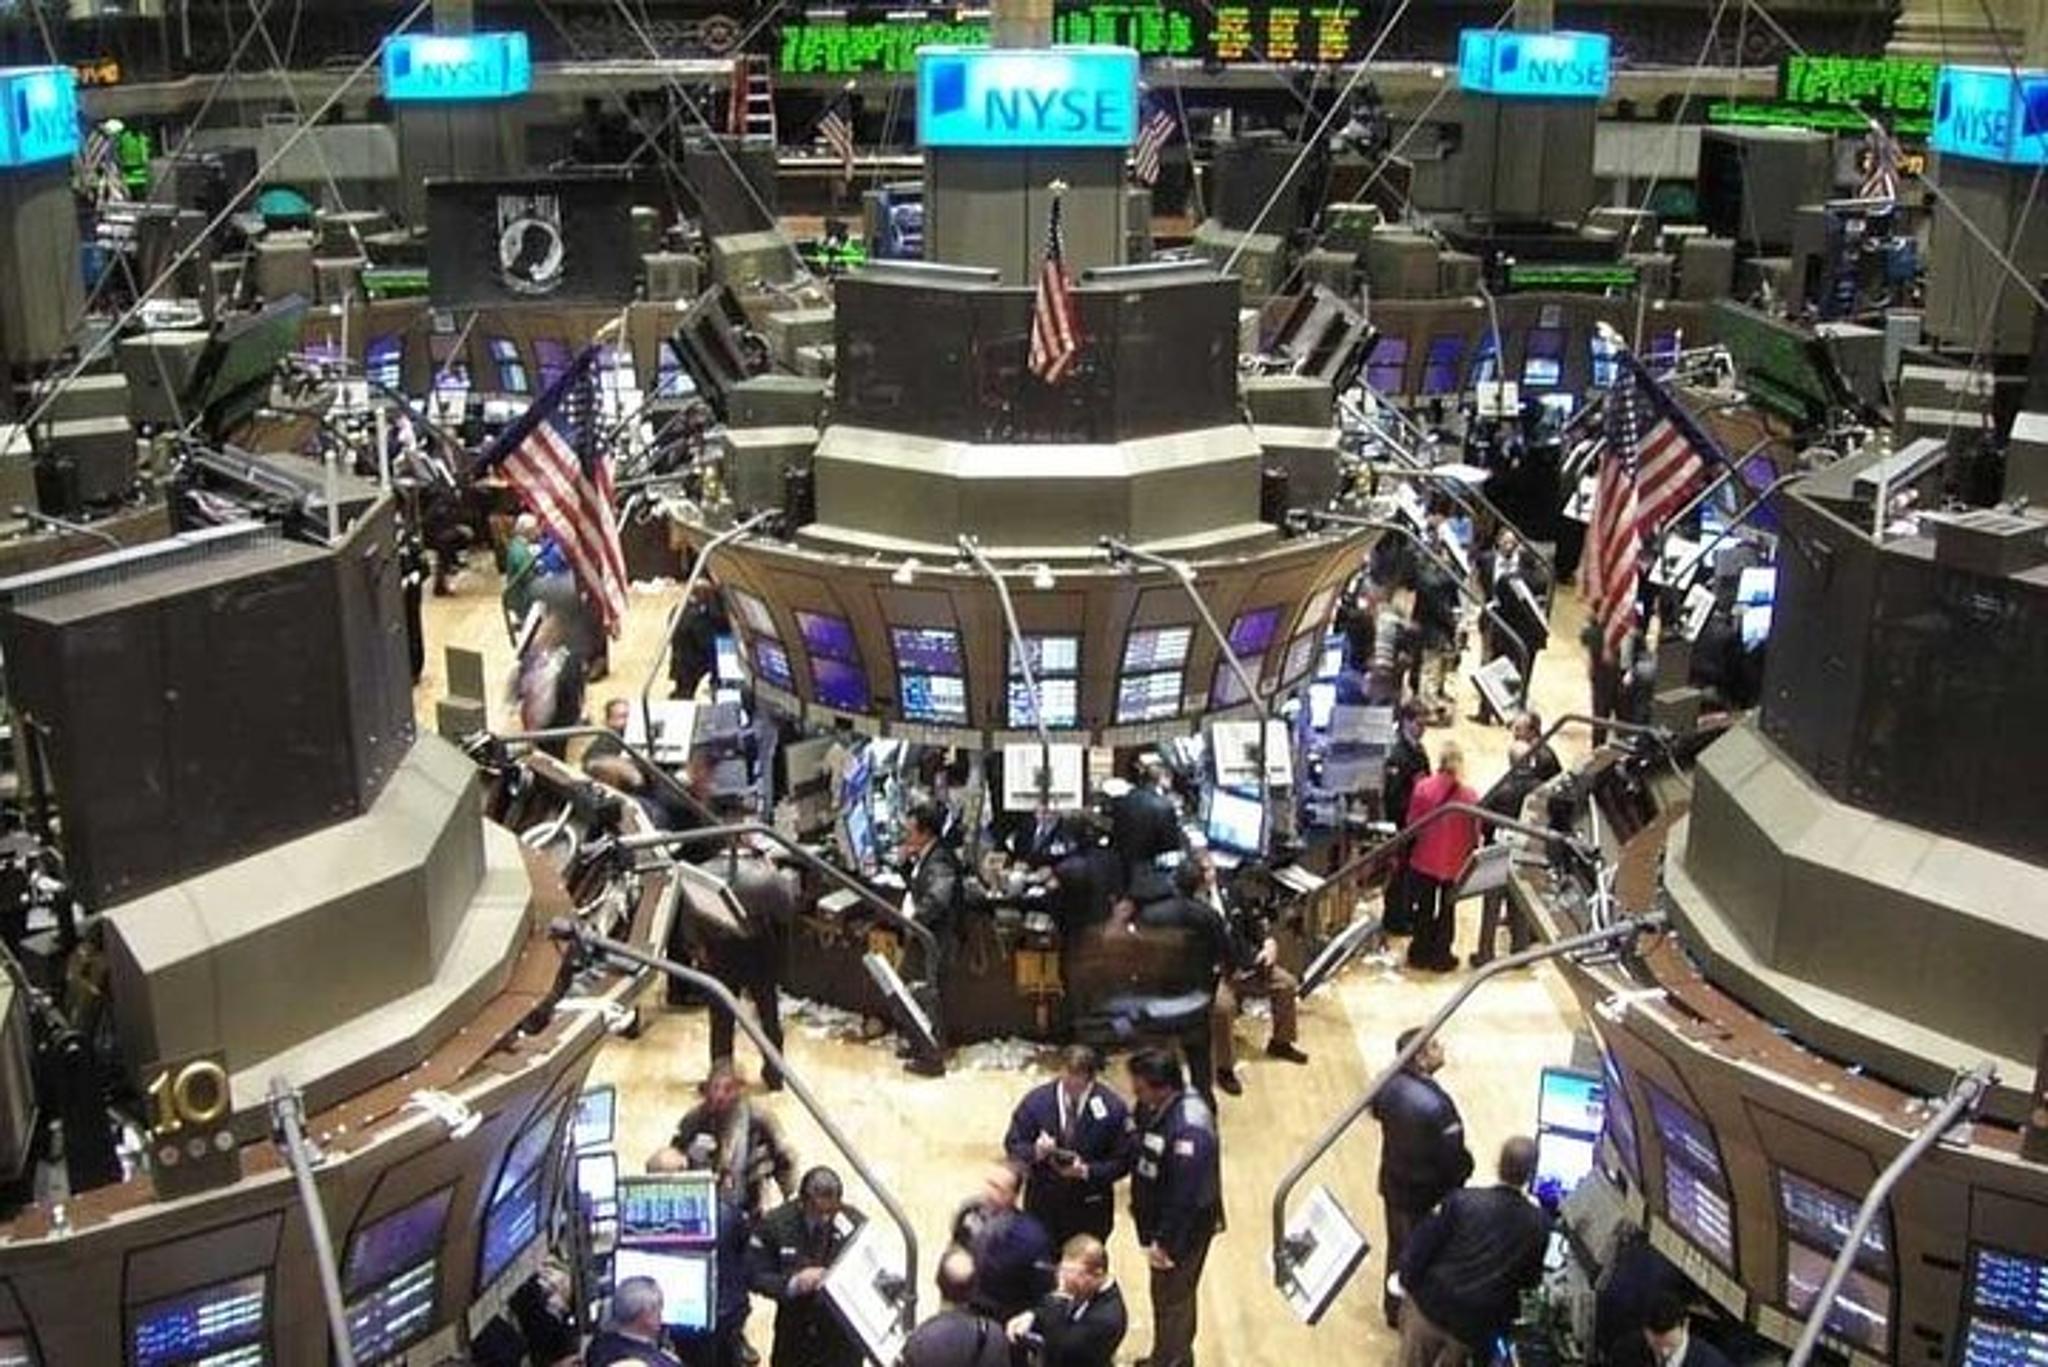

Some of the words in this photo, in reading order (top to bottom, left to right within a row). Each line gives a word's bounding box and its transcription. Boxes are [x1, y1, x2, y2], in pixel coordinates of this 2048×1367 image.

[1527, 58, 1604, 86] NYSE
[985, 87, 1123, 132] NYSE
[1953, 104, 2007, 148] NYSE
[147, 1061, 230, 1133] 10
